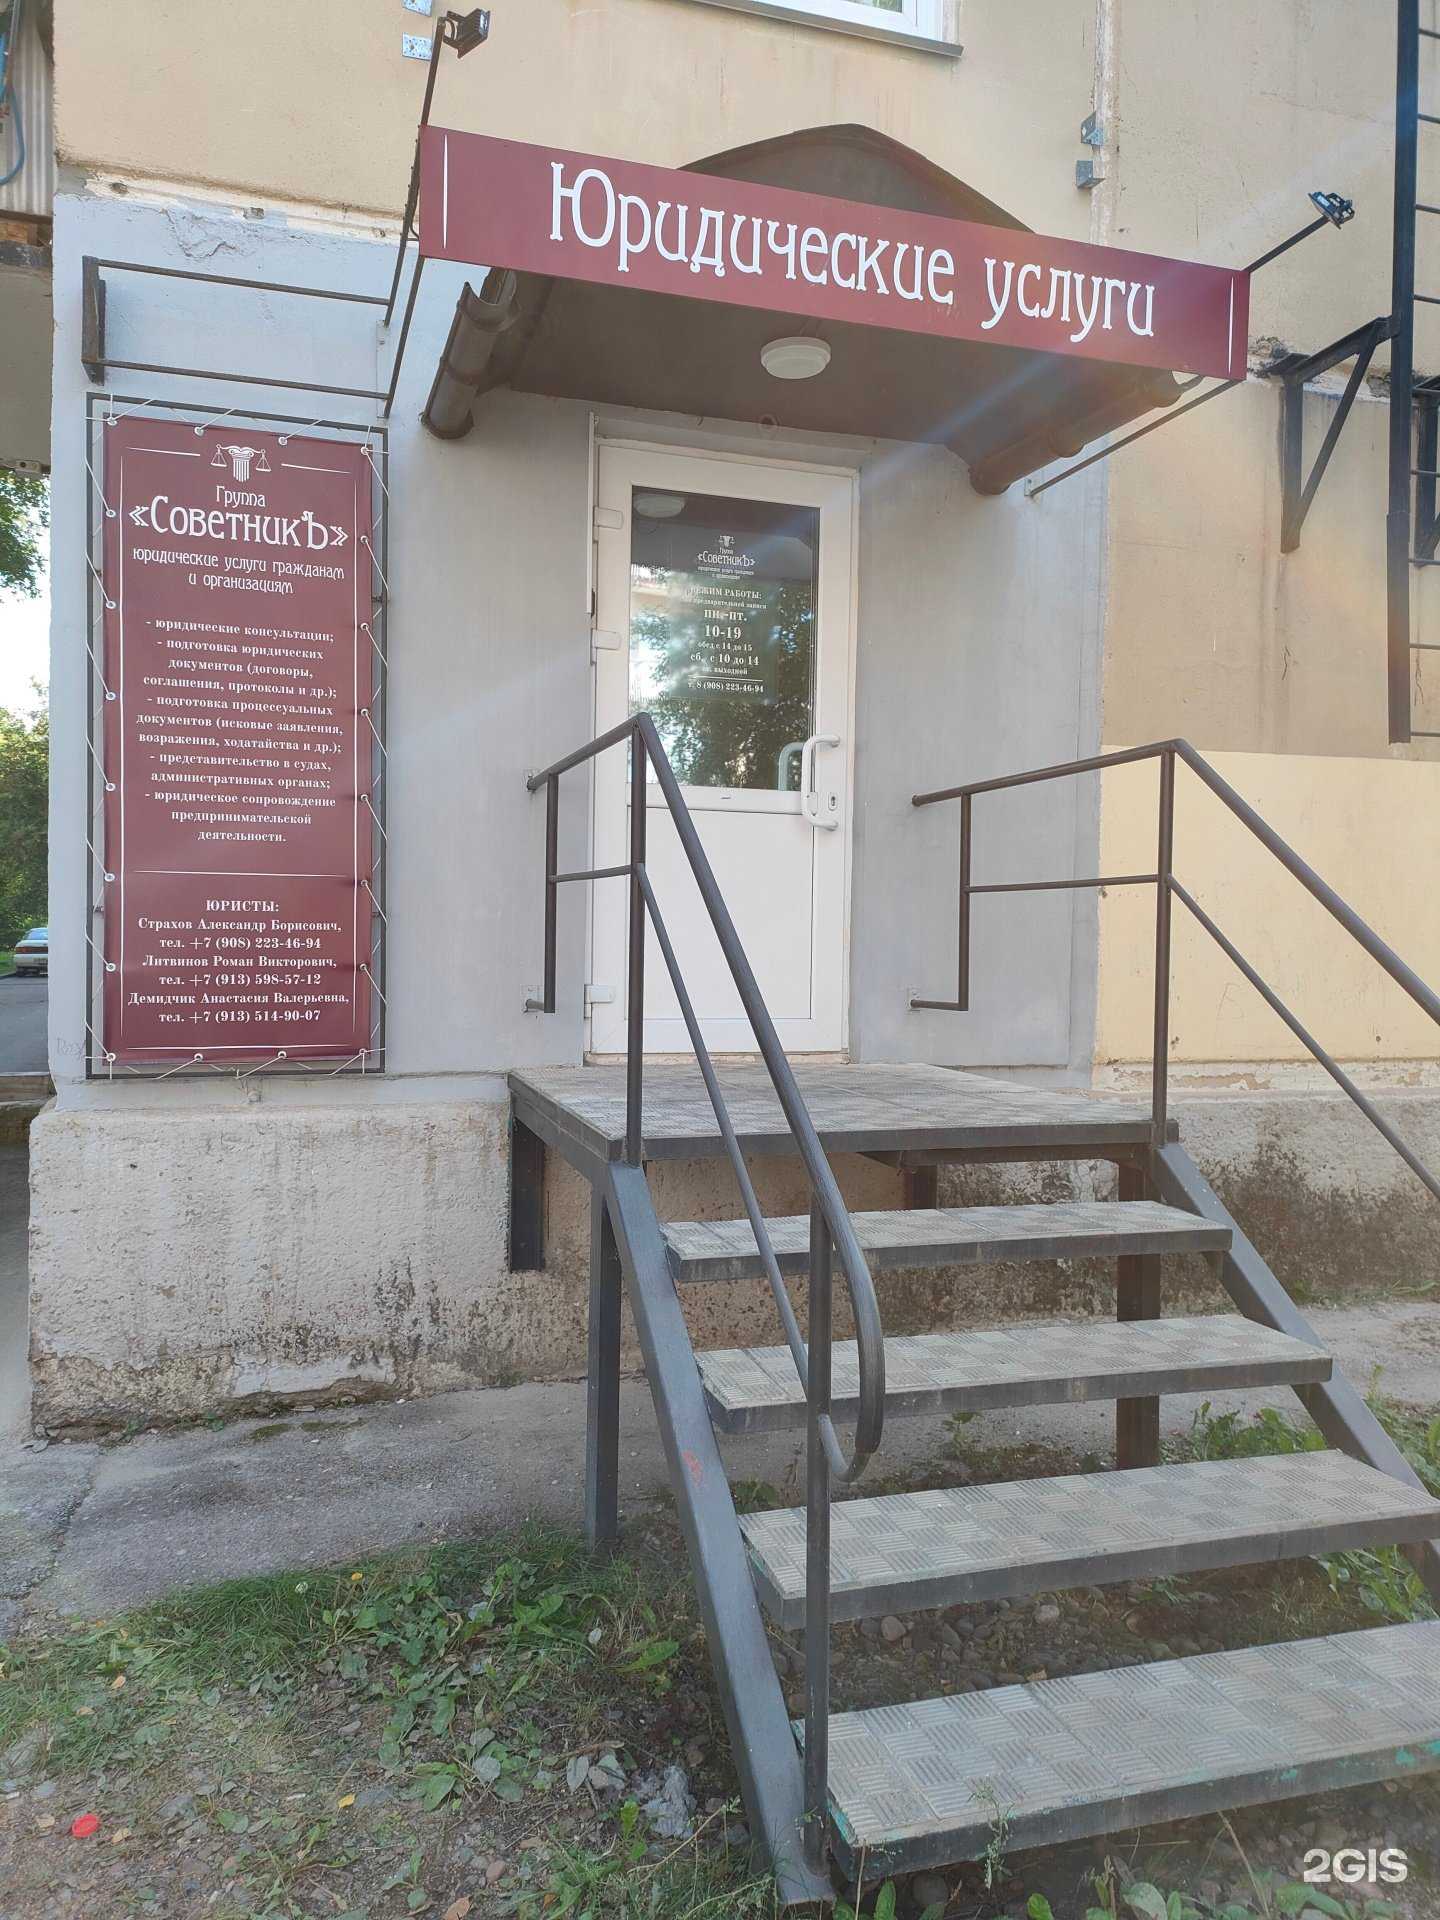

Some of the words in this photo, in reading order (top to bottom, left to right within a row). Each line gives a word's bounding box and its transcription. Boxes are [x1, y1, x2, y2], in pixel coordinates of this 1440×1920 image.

[549, 162, 955, 305] Юридические
[982, 258, 1154, 342] услуги
[216, 485, 266, 508] Группа
[128, 496, 349, 550] «СоветникЪ»
[133, 547, 219, 567] юридические
[224, 556, 267, 574] услуги
[272, 560, 345, 580] гражданам
[188, 572, 197, 585] и
[203, 574, 294, 595] организациям
[155, 619, 240, 634] юридические
[244, 626, 334, 643] консультации;
[705, 625, 742, 639] 10-19
[166, 639, 238, 654] подготовка
[242, 645, 324, 660] юридических
[168, 658, 243, 672] документов
[247, 662, 313, 679] (договоры,
[719, 653, 730, 663] 10
[748, 655, 759, 666] 14
[143, 675, 224, 691] соглашения,
[228, 681, 295, 695] протоколы
[298, 686, 306, 695] и
[157, 695, 229, 710] подготовка
[232, 700, 334, 715] процессуальных
[136, 713, 212, 727] документов
[216, 718, 273, 731] (исковые
[276, 721, 343, 736] заявления,
[138, 733, 220, 747] возражения,
[223, 736, 299, 751] ходатайства
[303, 742, 311, 751] и
[159, 752, 280, 768] представительство
[283, 760, 290, 768] в
[294, 760, 332, 772] судах,
[151, 771, 274, 787] административных
[278, 778, 331, 789] органах;
[154, 791, 238, 803] юридическое
[242, 795, 336, 808] сопровождение
[171, 810, 312, 825] предпринимательской
[197, 831, 287, 843] деятельности.
[205, 899, 280, 913] ЮРИСТЫ:
[138, 918, 193, 931] Страхов
[196, 918, 266, 933] Александр
[271, 919, 342, 933] Борисович,
[159, 938, 185, 948] тел.
[189, 936, 212, 950] +7
[215, 936, 251, 949] (908)
[255, 937, 321, 949] 223-46-94
[142, 955, 208, 968] Литвинов
[213, 955, 253, 967] Роман
[258, 956, 337, 969] Викторович,
[158, 974, 185, 985] тел.
[189, 973, 211, 987] +7
[215, 973, 251, 987] (913)
[255, 973, 321, 985] 598-57-12
[127, 992, 196, 1006] Демидчик
[200, 992, 269, 1004] Анастасия
[273, 992, 349, 1006] Валерьевна,
[158, 1012, 185, 1022] тел.
[189, 1010, 211, 1023] +7
[215, 1009, 250, 1023] (913)
[254, 1009, 321, 1022] 514-90-07
